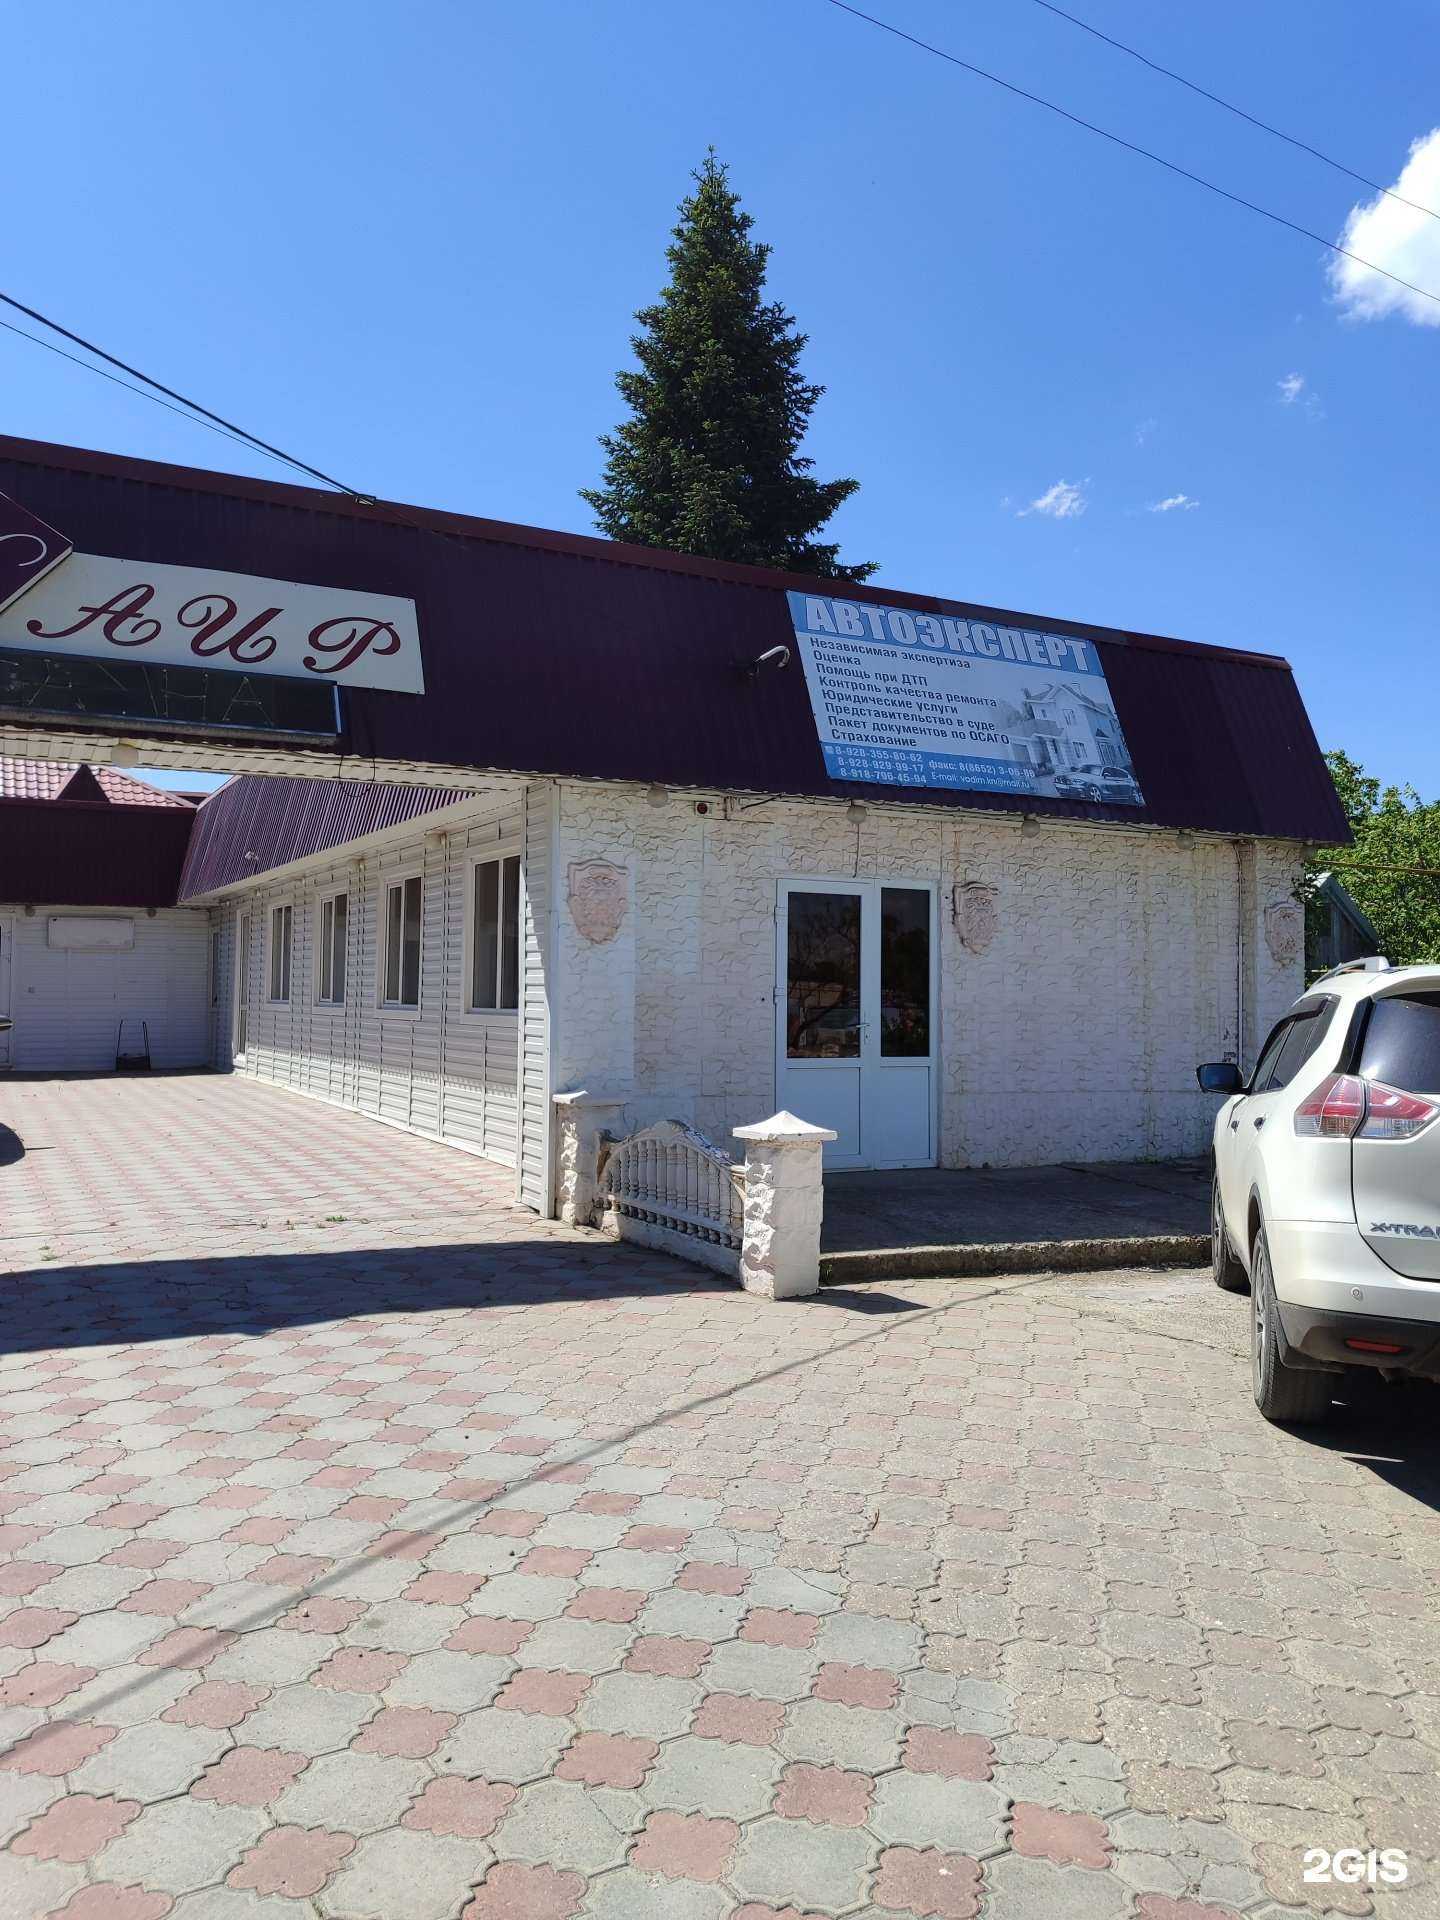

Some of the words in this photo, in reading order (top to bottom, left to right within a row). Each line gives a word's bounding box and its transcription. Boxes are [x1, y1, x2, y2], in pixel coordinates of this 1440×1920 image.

[806, 597, 1088, 671] АВТОЭКСПЕРТ
[810, 637, 898, 658] Независимая
[901, 651, 970, 669] экспертиза
[813, 650, 862, 666] Оценка
[816, 663, 871, 680] Помощь
[875, 672, 898, 683] при
[902, 674, 928, 687] ДТП
[819, 676, 882, 693] Контроль
[886, 686, 943, 701] качества
[946, 693, 998, 708] ремонта
[822, 689, 913, 709] Юридические
[916, 701, 959, 715] услуги
[825, 703, 953, 727] Представительство
[957, 719, 963, 728] в
[967, 720, 995, 732] суде
[828, 715, 867, 730] Пакет
[872, 722, 947, 739] документов
[952, 731, 966, 740] по
[969, 731, 1010, 745] ОСАГО
[831, 729, 917, 747] Страхование
